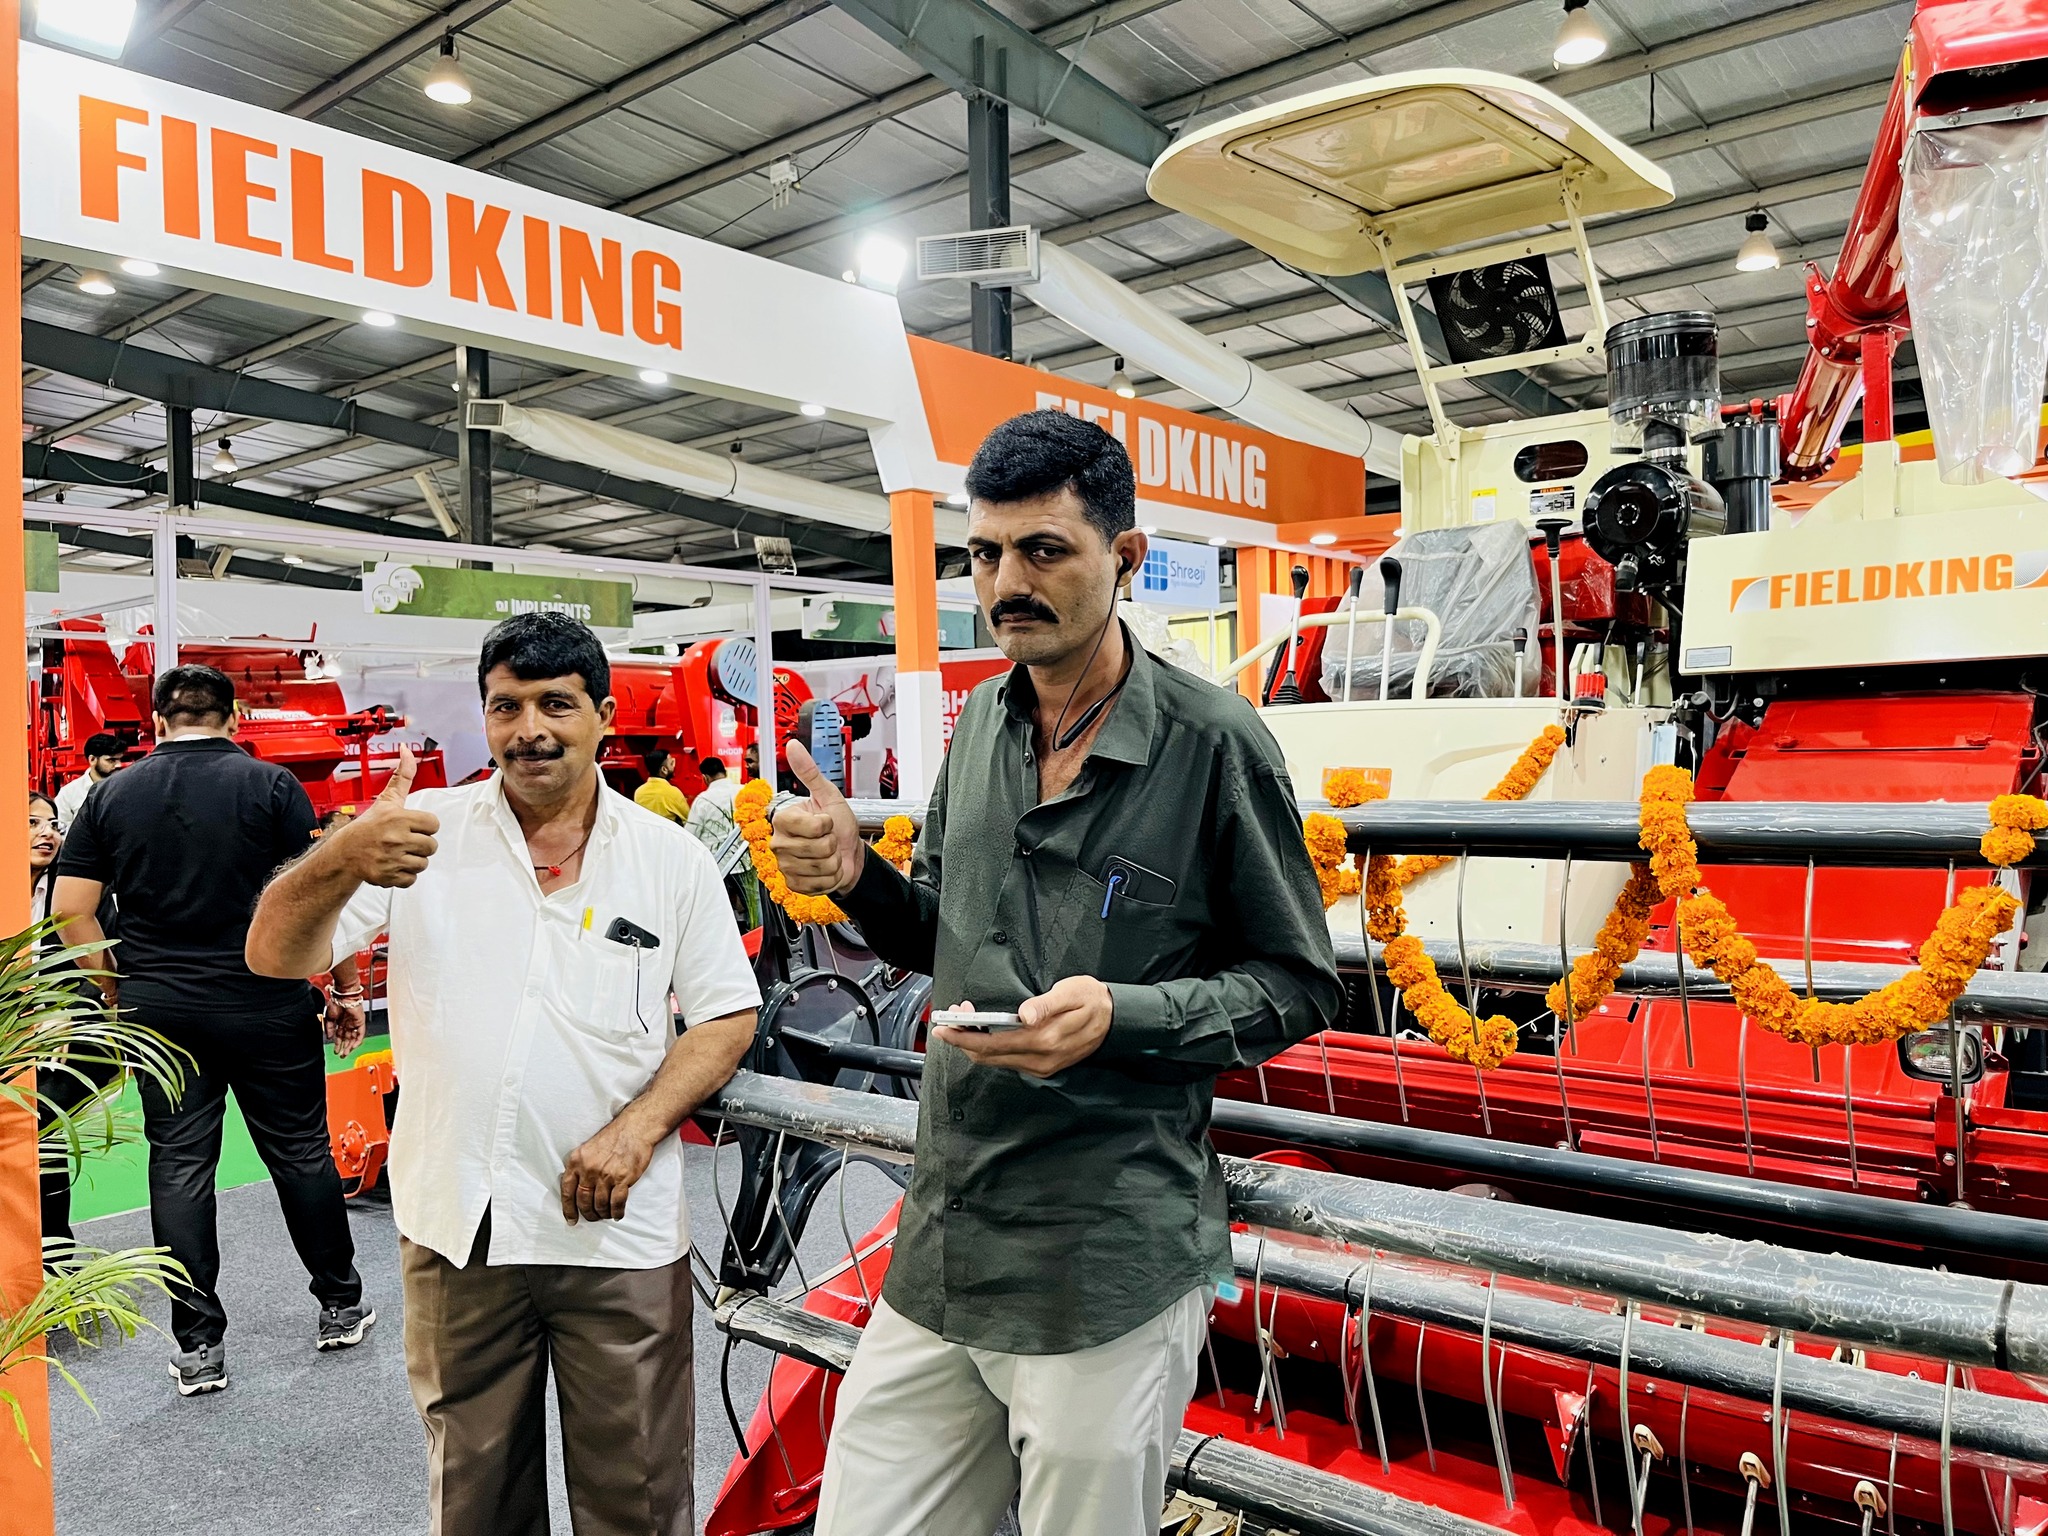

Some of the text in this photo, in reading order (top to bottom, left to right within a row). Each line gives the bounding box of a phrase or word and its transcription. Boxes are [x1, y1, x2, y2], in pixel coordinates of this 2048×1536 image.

[79, 94, 683, 350] FIELDKING
[1170, 560, 1206, 585] Shreeji
[1769, 553, 2013, 609] FIELDKING
